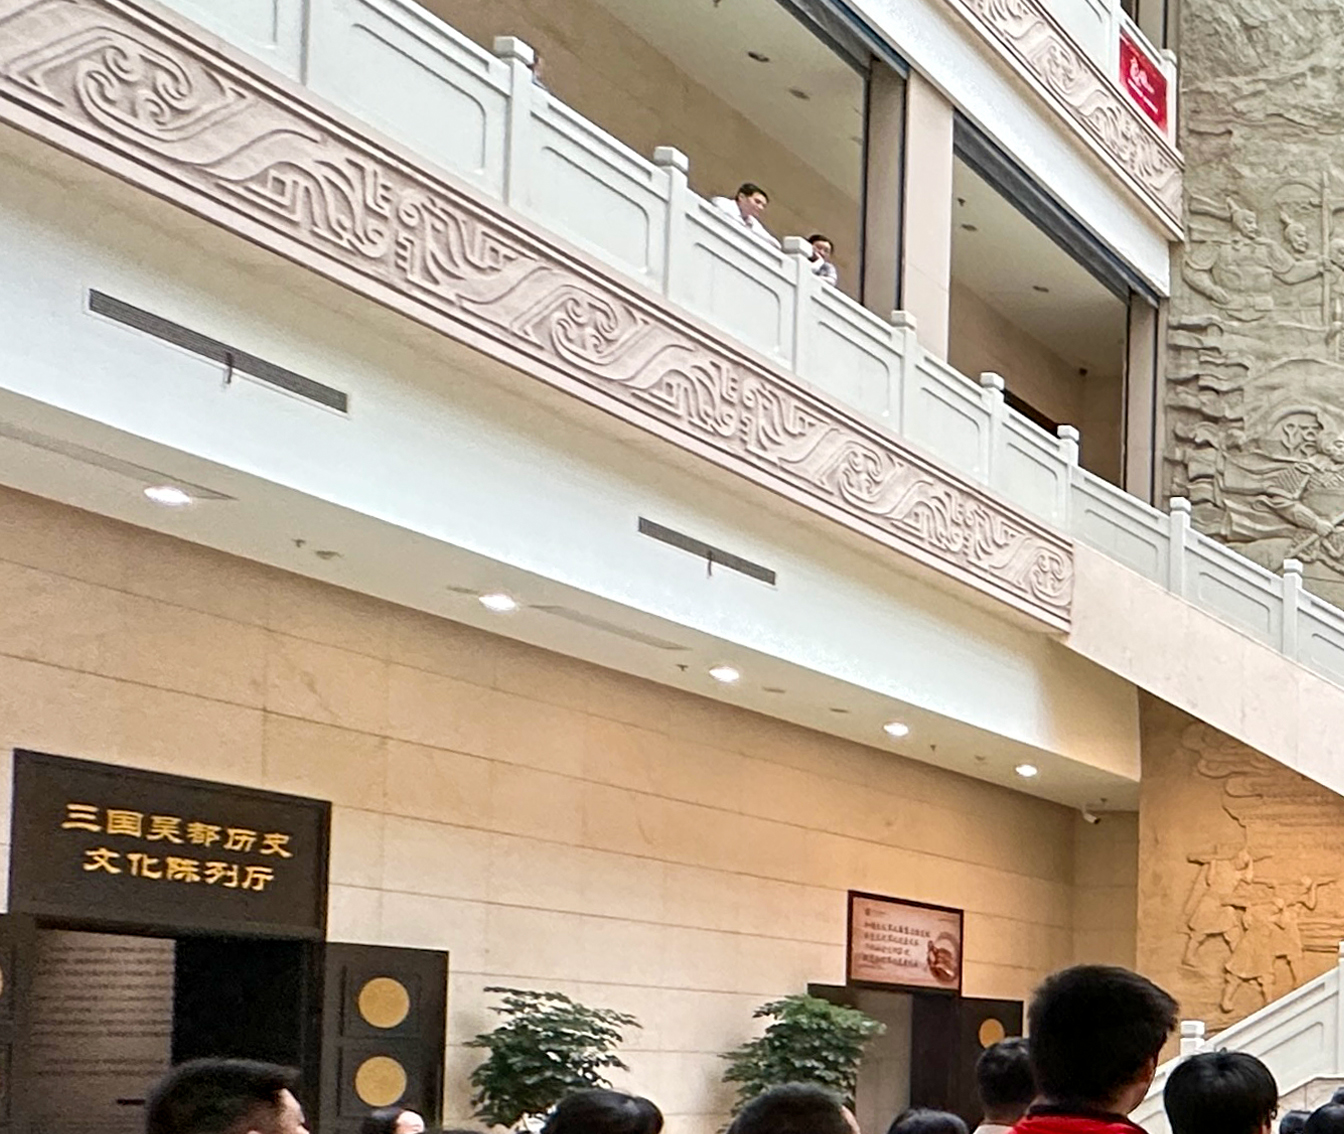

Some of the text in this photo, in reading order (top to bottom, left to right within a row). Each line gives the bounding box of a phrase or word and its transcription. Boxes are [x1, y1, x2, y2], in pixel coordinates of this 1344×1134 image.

[61, 803, 294, 858] 三国吴都历史
[83, 848, 275, 891] 文化陈列厅
